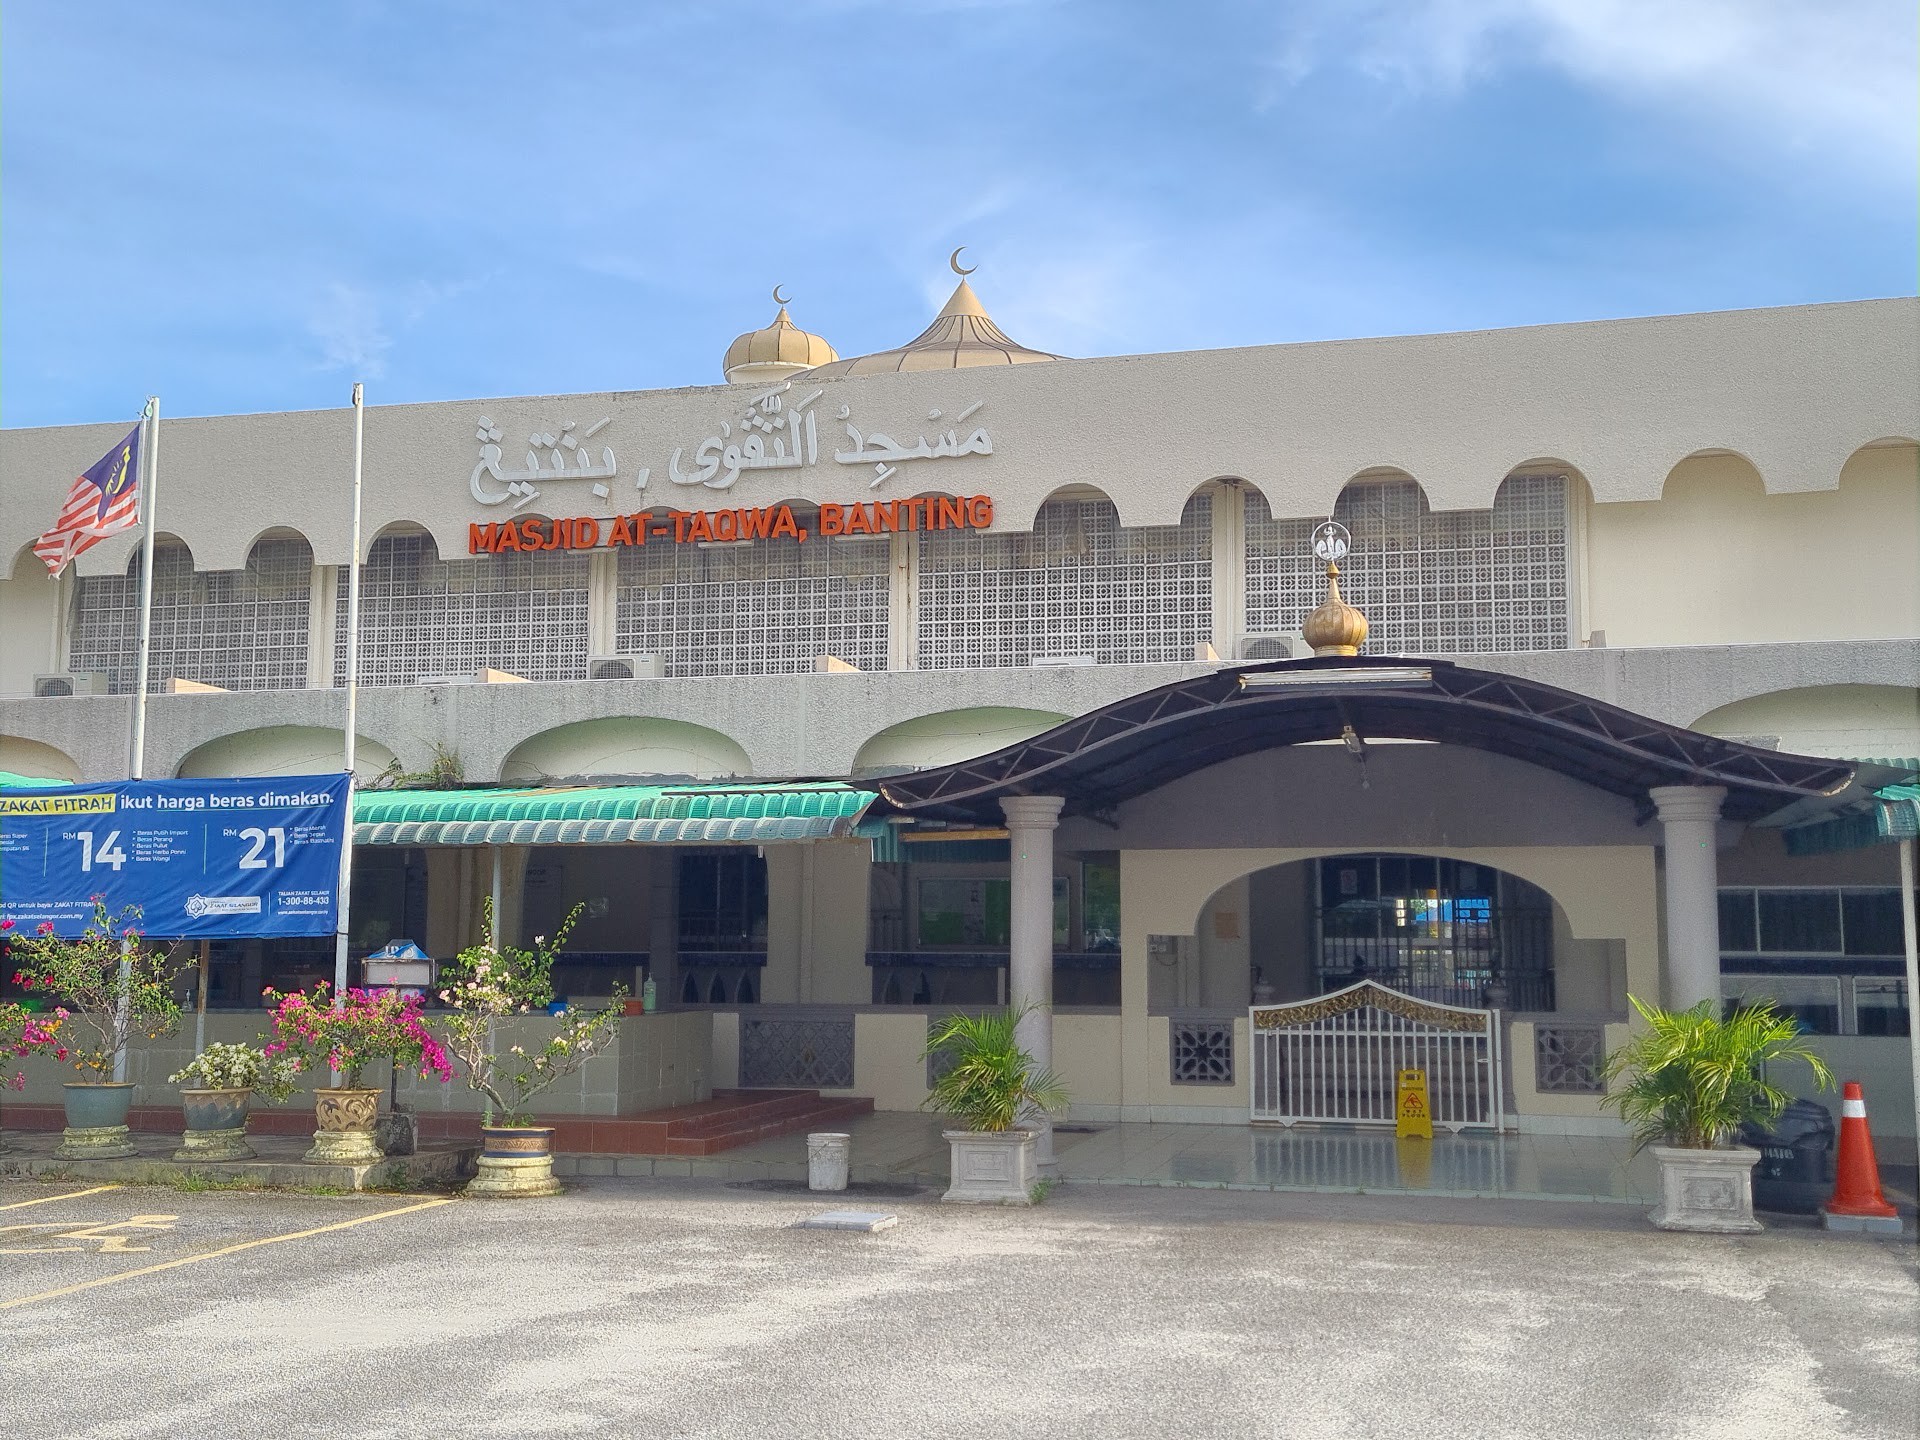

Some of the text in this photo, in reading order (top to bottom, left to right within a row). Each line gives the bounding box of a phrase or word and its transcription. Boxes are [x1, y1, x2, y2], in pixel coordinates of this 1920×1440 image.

[468, 495, 993, 554] MASJID AT-TAQWA, BANTING
[0, 791, 335, 812] ZAKAT FITRAH ikut harga beras dimakan.
[169, 829, 189, 837] Import
[223, 827, 286, 869] RM 21
[62, 830, 127, 872] RM 14
[37, 901, 53, 910] bayar
